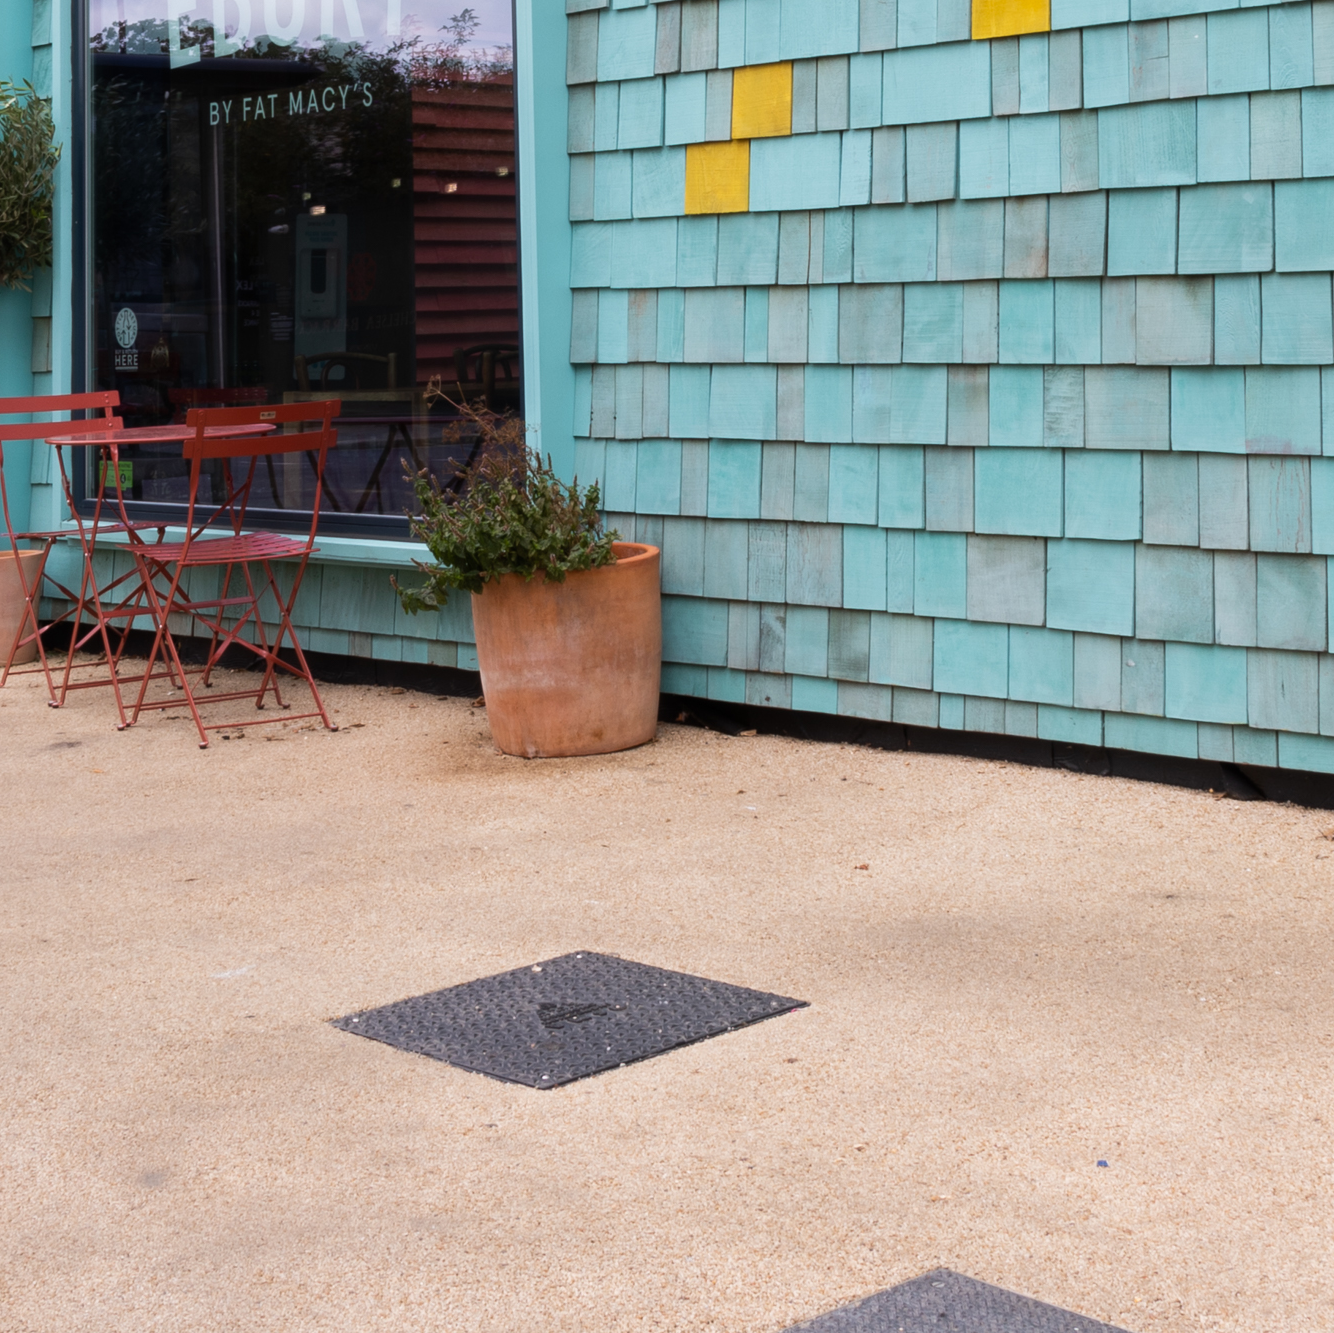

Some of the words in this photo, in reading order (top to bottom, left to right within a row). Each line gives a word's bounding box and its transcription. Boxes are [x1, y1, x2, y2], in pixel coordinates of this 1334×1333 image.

[209, 100, 233, 126] BY
[243, 94, 278, 122] FAT
[289, 82, 373, 116] MACY'S
[114, 354, 138, 366] HERE
